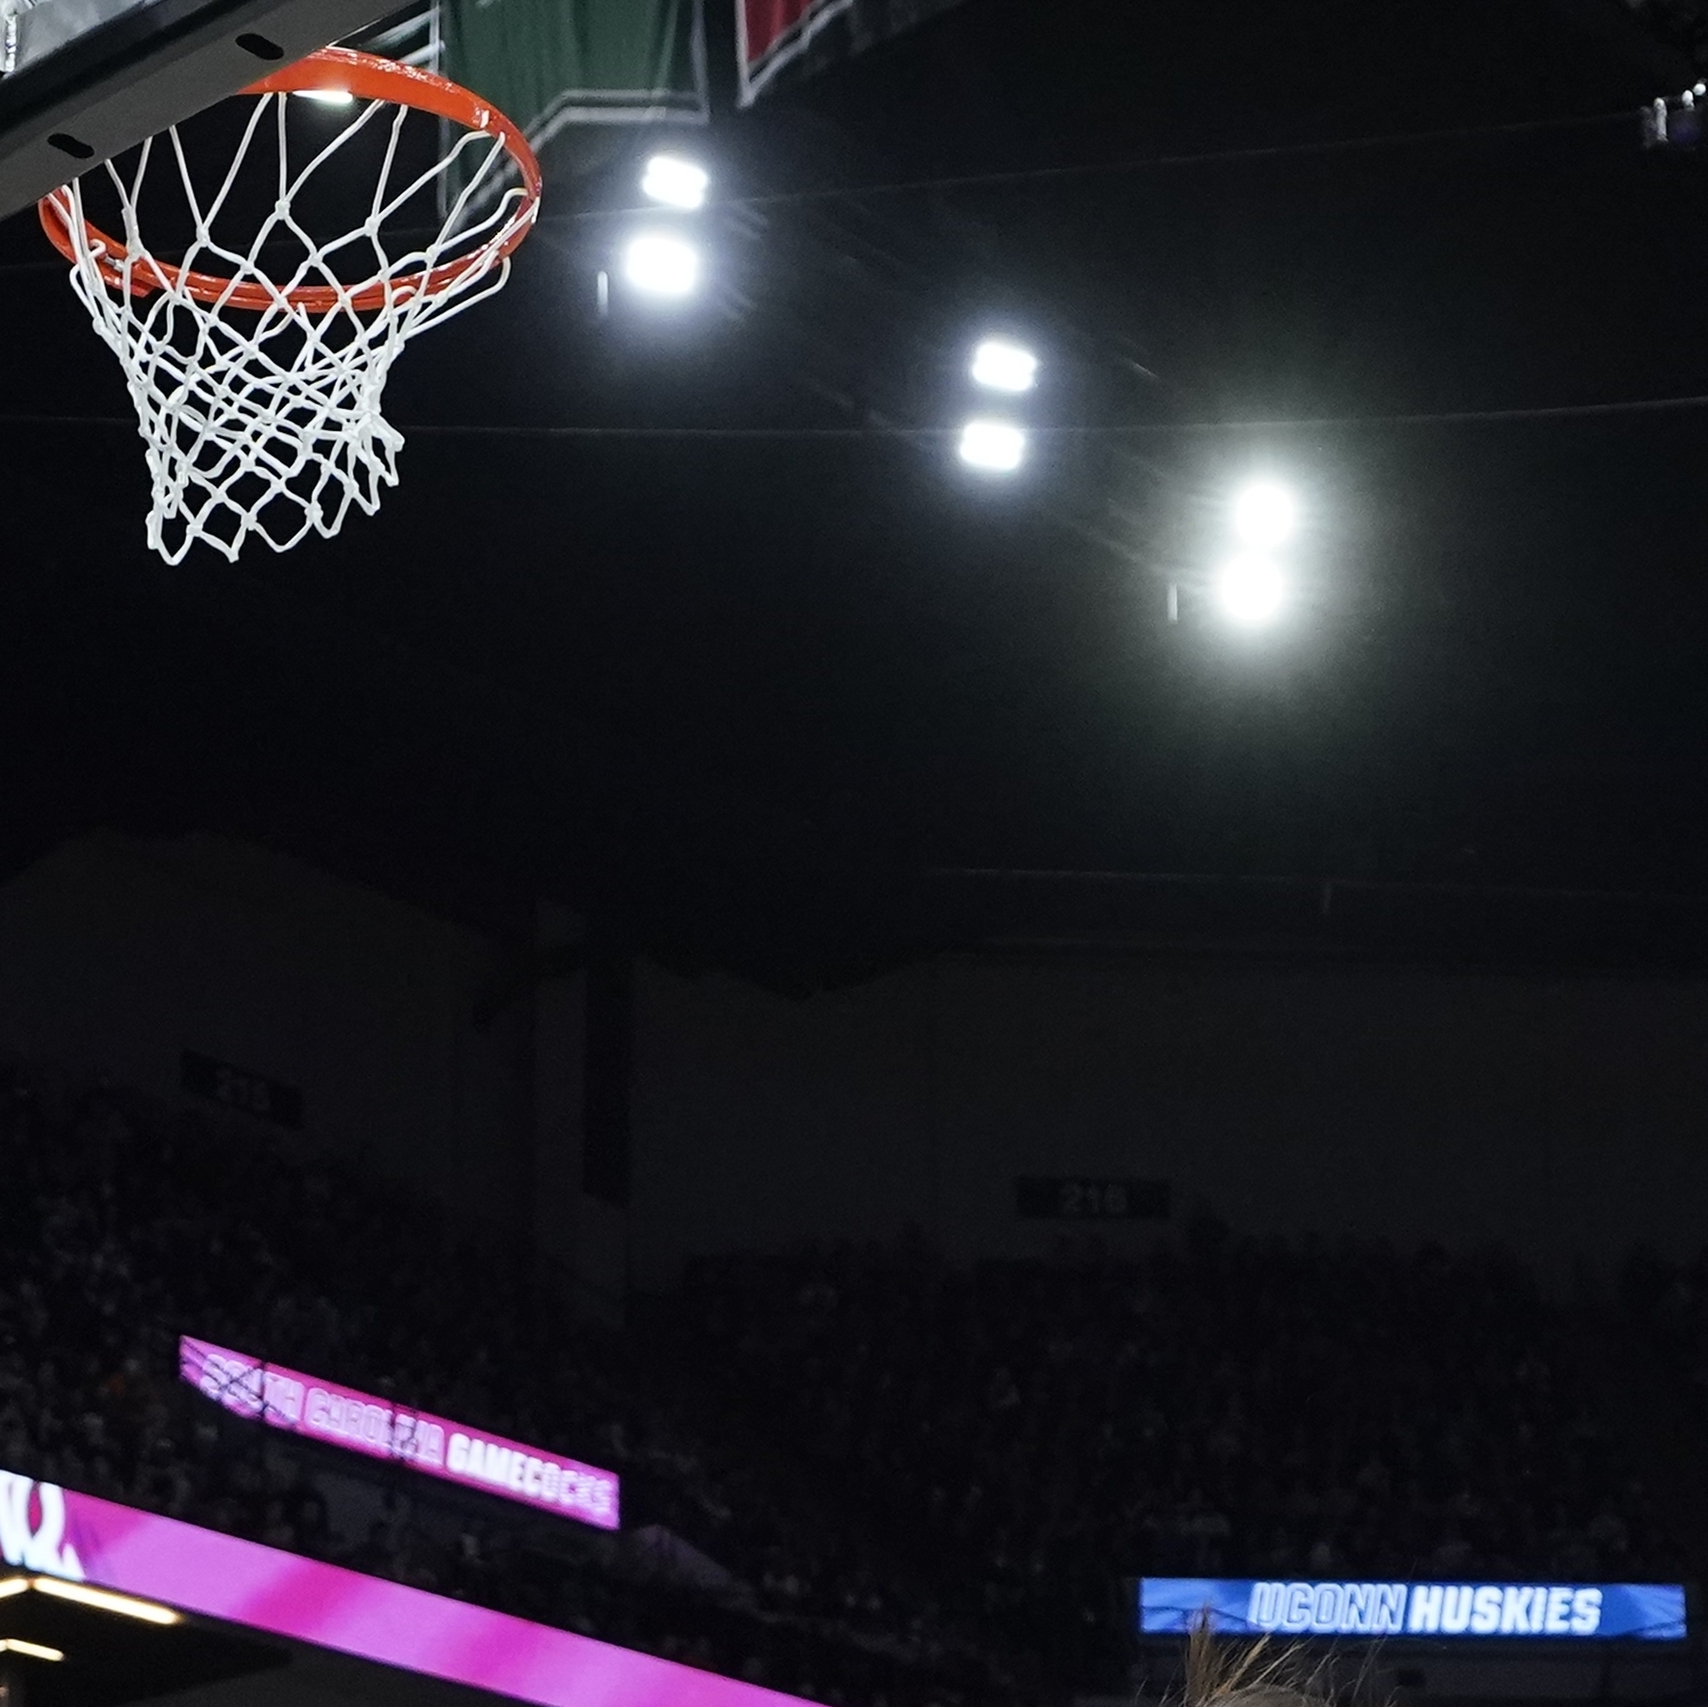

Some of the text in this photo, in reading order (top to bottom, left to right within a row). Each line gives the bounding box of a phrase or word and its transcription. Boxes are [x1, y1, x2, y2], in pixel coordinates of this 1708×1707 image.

[201, 1352, 614, 1516] SOUTH CAROLINA GAMECOCKS
[1249, 1582, 1603, 1635] UCONN HUSKIES
